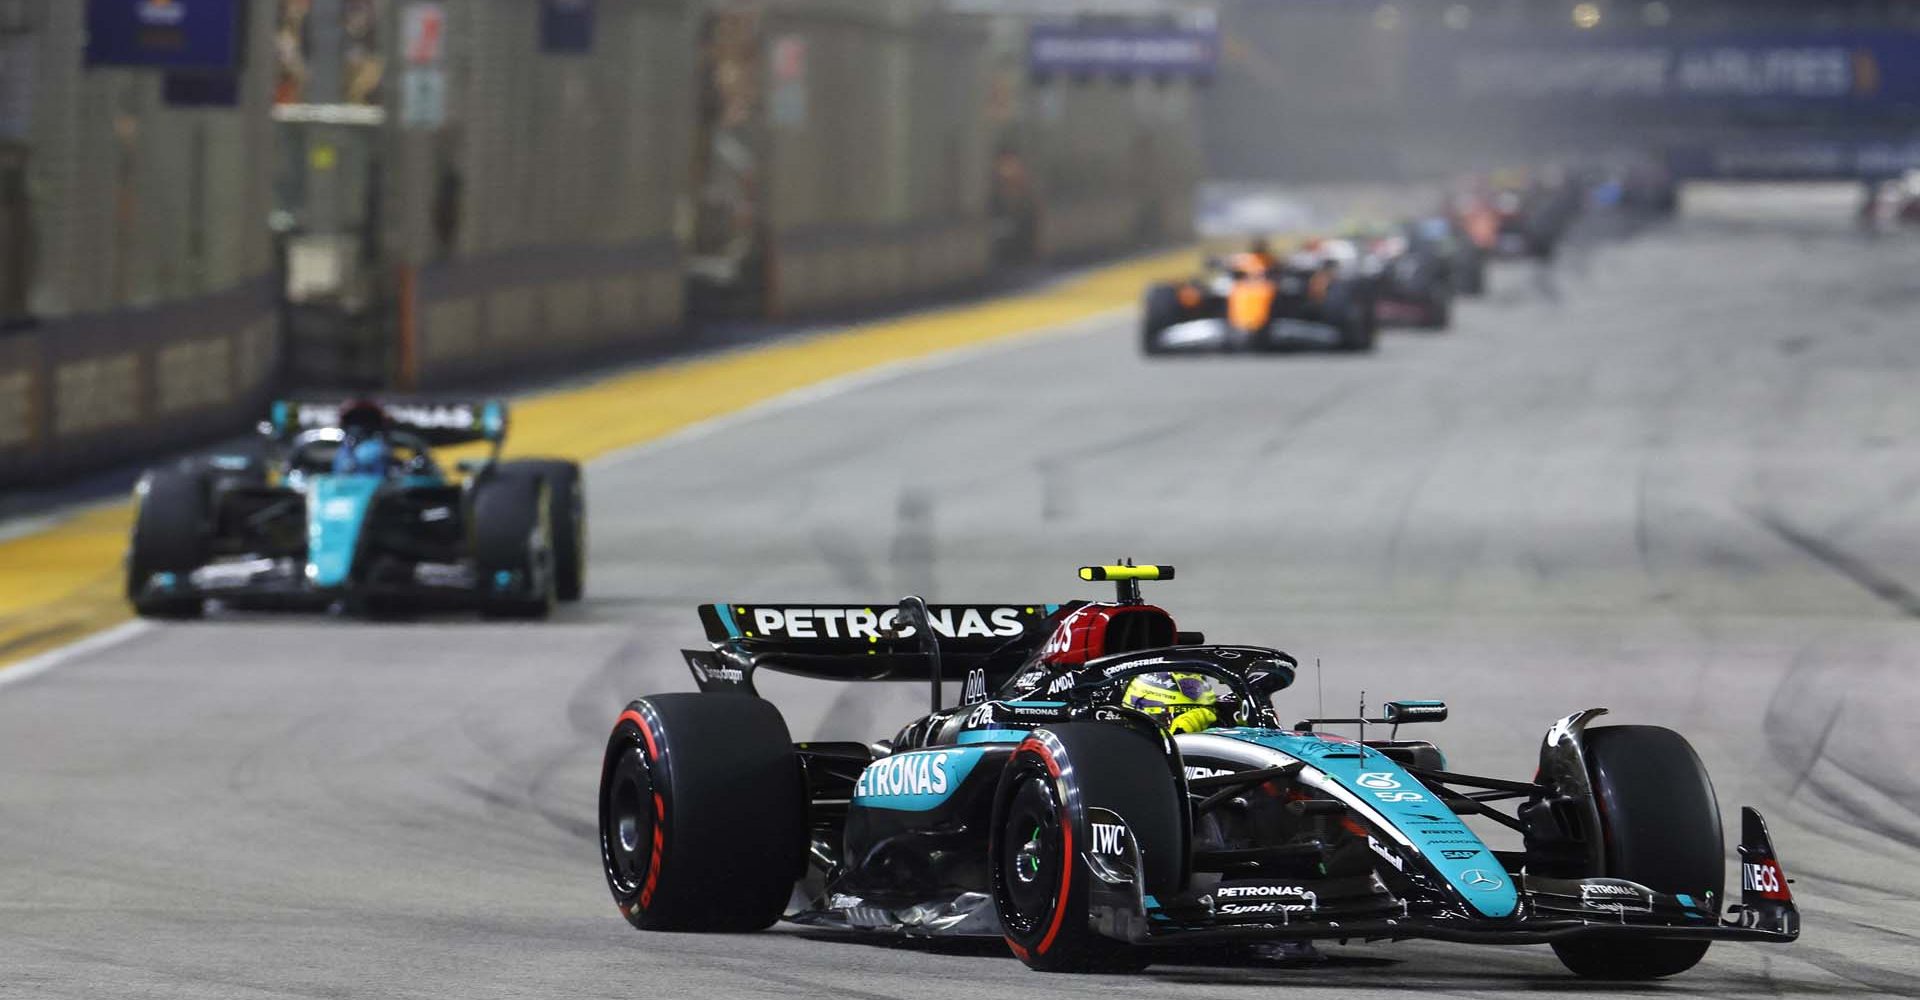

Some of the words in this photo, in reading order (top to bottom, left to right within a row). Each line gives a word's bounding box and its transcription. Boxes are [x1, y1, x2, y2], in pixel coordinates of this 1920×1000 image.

[1106, 657, 1164, 675] CROWDSTRIKE
[1015, 708, 1058, 716] PETRONAS
[1091, 823, 1125, 856] IWC
[1443, 851, 1475, 859] SAP
[1743, 863, 1779, 892] INEOS
[1217, 886, 1304, 897] PETRONAS
[1580, 884, 1639, 896] PETRONAS
